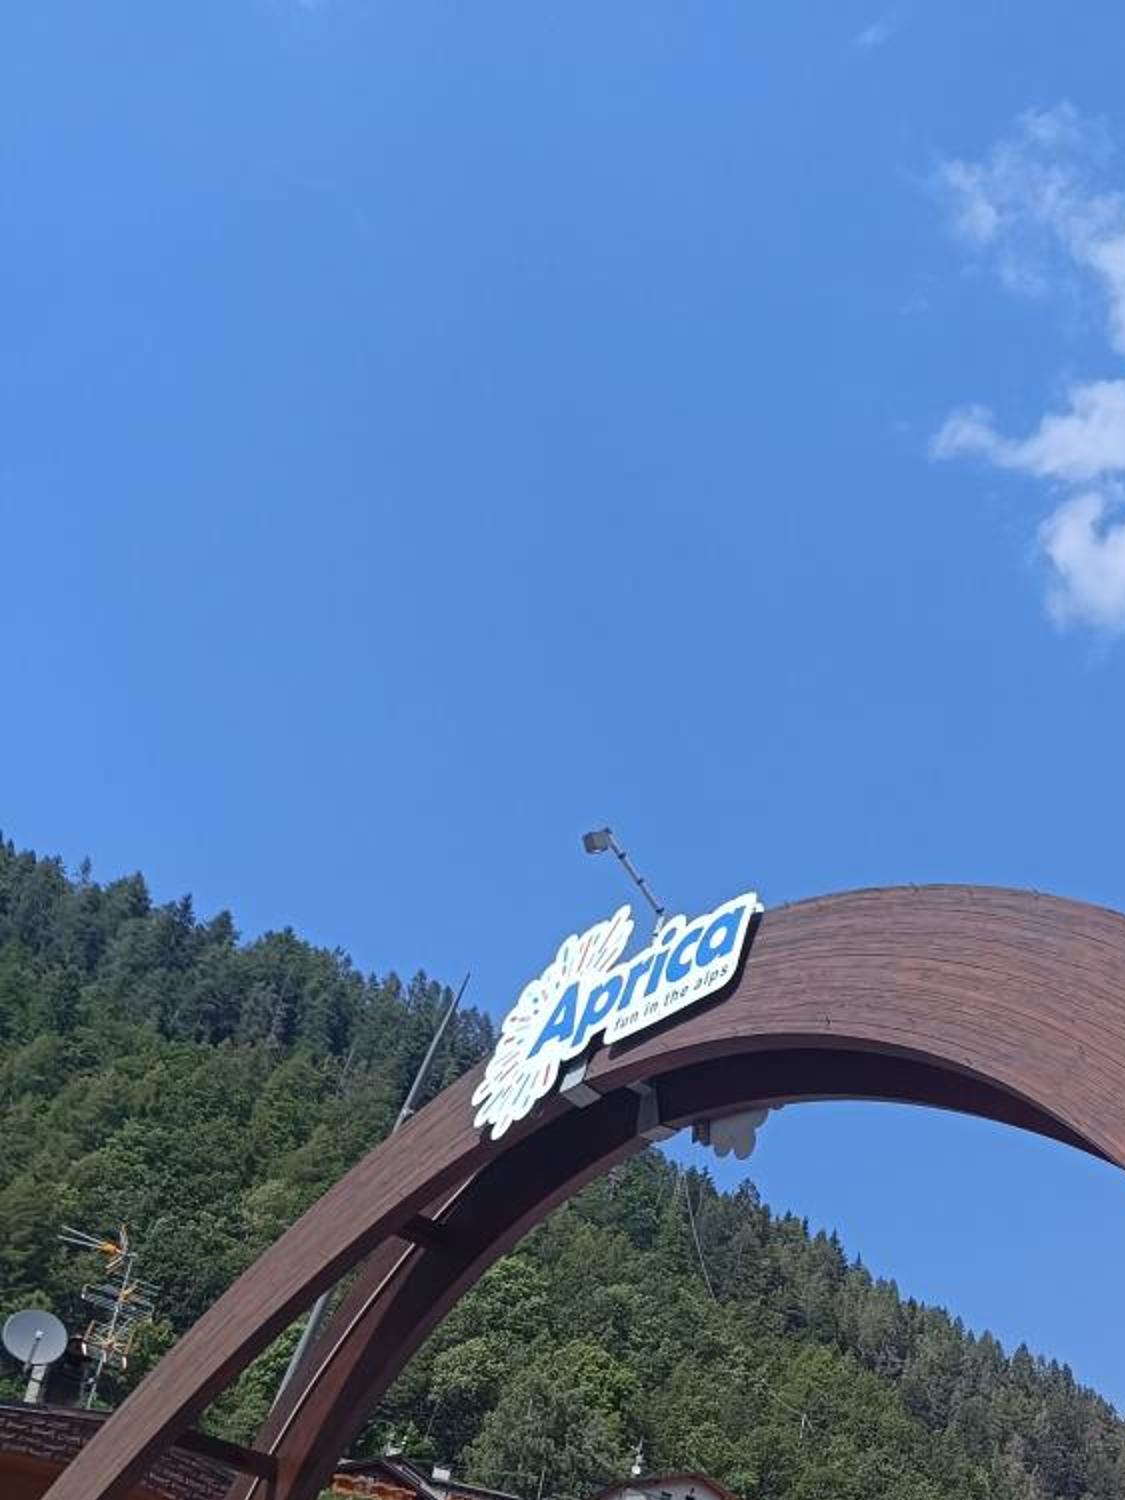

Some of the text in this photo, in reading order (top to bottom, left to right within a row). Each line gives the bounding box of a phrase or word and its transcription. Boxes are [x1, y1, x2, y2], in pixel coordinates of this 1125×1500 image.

[526, 905, 748, 1060] Aprica
[613, 964, 729, 1032] fun in the alps
